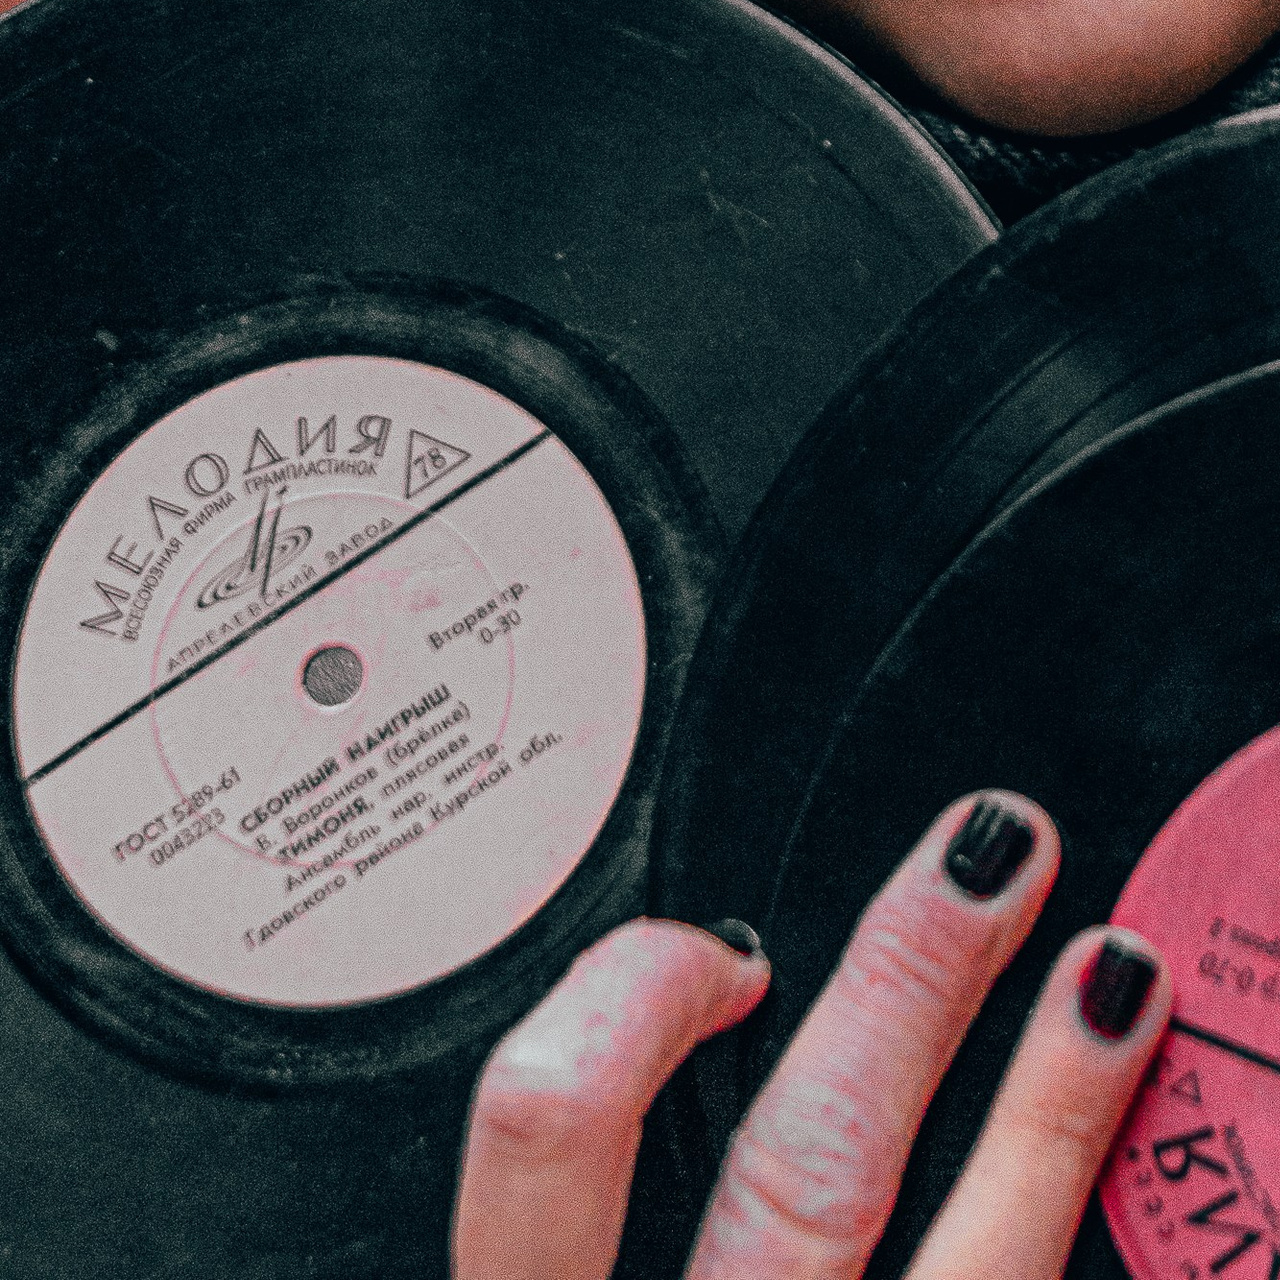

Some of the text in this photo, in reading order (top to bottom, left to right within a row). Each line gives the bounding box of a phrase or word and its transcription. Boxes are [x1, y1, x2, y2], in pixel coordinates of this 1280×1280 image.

[412, 447, 446, 479] 78
[79, 414, 393, 639] МЕЛОДИЯ
[121, 456, 379, 643] ВСЕСОЮЗНАЯ ФИРМА ГРАМПЛАСТИНОК
[167, 517, 394, 673] АПРЕЛЕВСКИЙ ЗАВОД
[427, 599, 499, 651] Вторая
[479, 609, 522, 645] 0-30
[240, 684, 451, 833] СБОРНЫЙ НАИГРЫШ
[382, 734, 470, 797] плясовая
[113, 766, 241, 861] ГОСТ 5289-61
[282, 767, 378, 836] Воронков
[352, 822, 425, 878] района
[429, 763, 512, 823] Курской
[285, 825, 381, 893] Ансамбль
